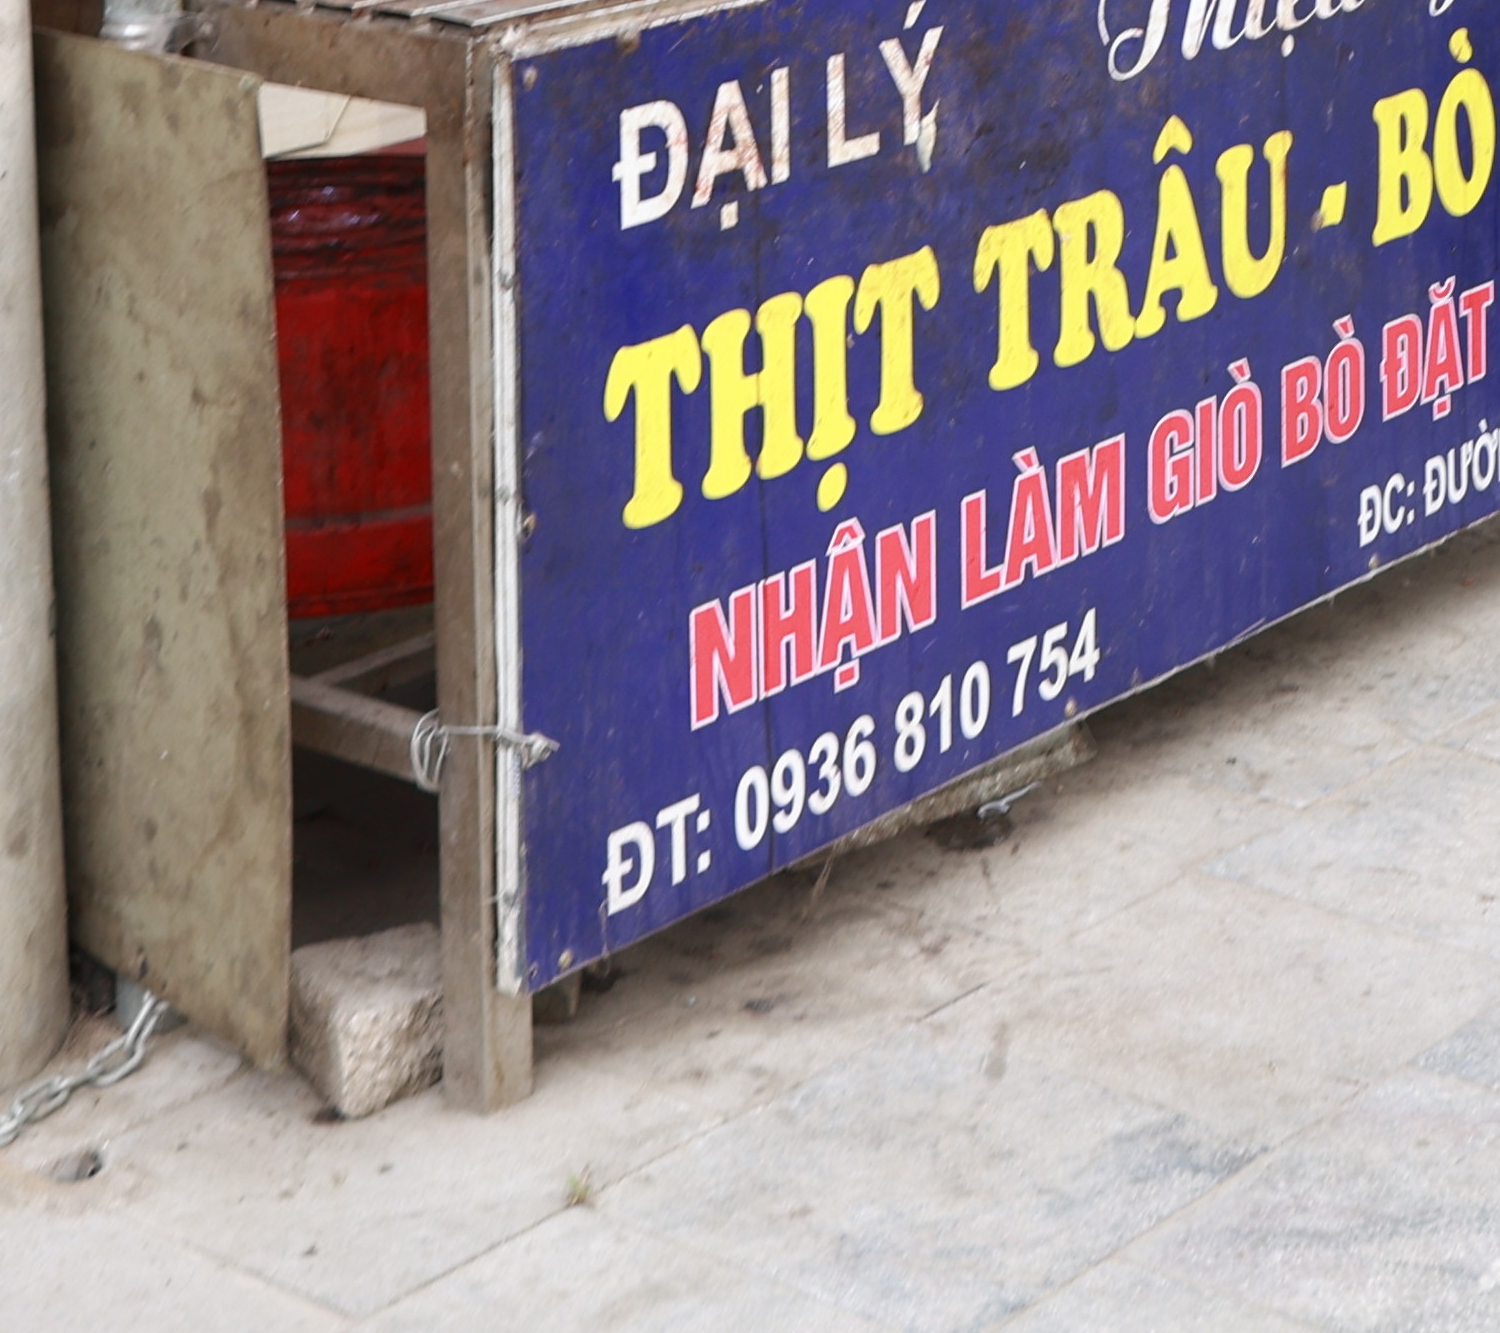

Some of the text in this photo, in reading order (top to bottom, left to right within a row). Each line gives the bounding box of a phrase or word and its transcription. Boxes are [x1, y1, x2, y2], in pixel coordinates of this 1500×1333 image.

[603, 244, 941, 531] THỊT
[973, 114, 1294, 391] TRÂU
[1371, 27, 1496, 247] BÒ
[611, 66, 791, 232] ĐẠI
[689, 515, 937, 732] NHẬN
[960, 431, 1126, 610] LÀM
[1147, 356, 1263, 525] GIÒ
[1280, 314, 1366, 469] BÒ
[1379, 275, 1495, 422] ĐẶT
[1358, 471, 1416, 548] ĐC:
[601, 607, 1101, 917] ĐT: 0936 810 754
